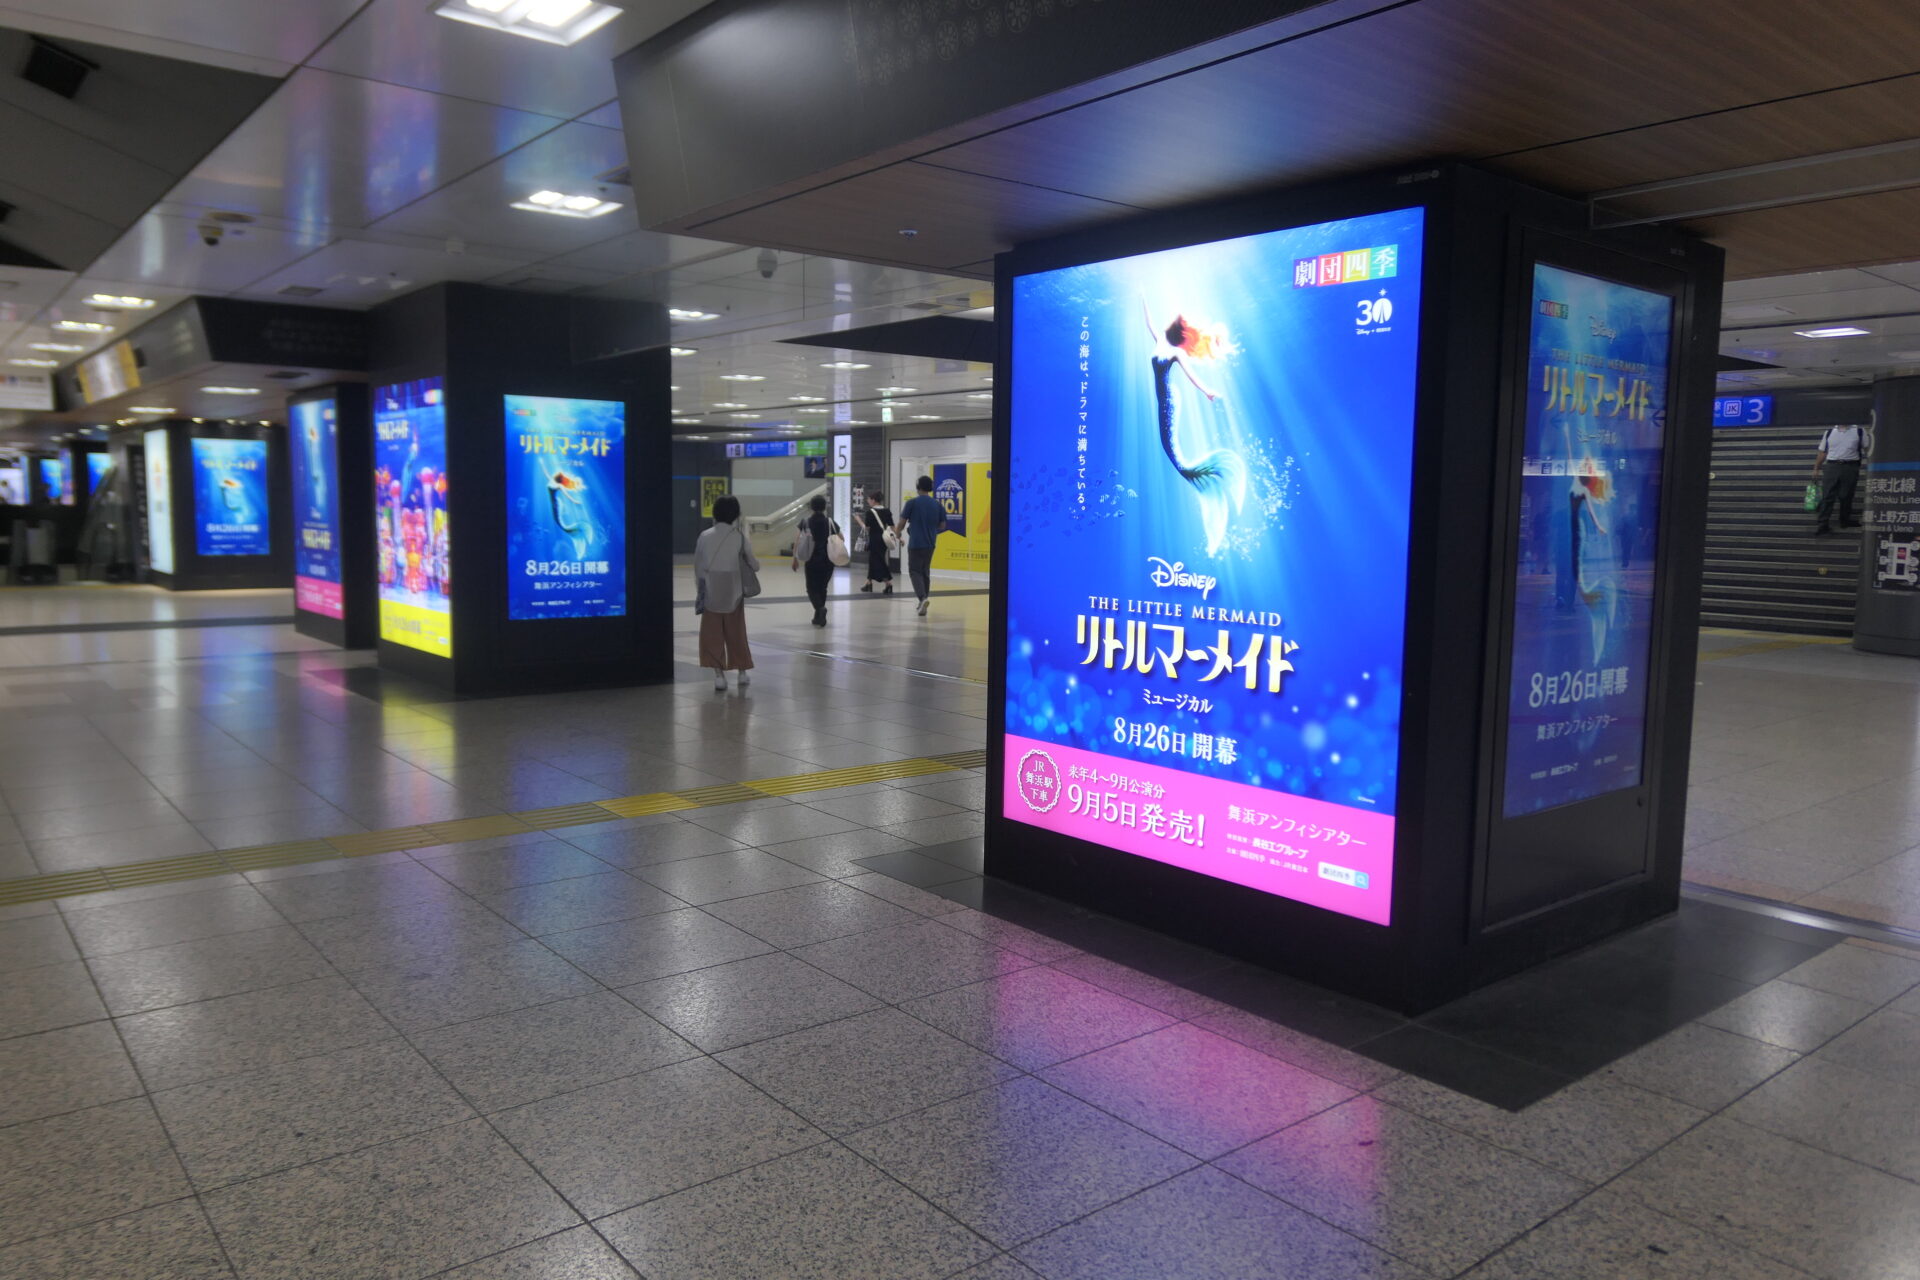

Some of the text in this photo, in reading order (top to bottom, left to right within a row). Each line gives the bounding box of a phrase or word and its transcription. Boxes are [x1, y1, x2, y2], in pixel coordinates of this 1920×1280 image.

[1294, 247, 1395, 287] 劇団四季
[1543, 365, 1654, 421] リトルマーメイド
[1076, 315, 1091, 511] この海は、ドラマに満ちている。
[1746, 399, 1765, 424] 3
[520, 434, 612, 457] リトルマーメイド
[838, 445, 847, 470] 5
[1147, 556, 1217, 600] Disney
[1088, 595, 1283, 627] THE LITTLE MERMAID
[1076, 614, 1300, 693] リトルマーメイド
[1143, 688, 1214, 714] ミュージカル
[1025, 771, 1054, 789] 舞浜駅
[1033, 759, 1045, 773] JR
[1030, 787, 1049, 803] 下車
[1227, 804, 1369, 847] 舞浜アンフィシアター
